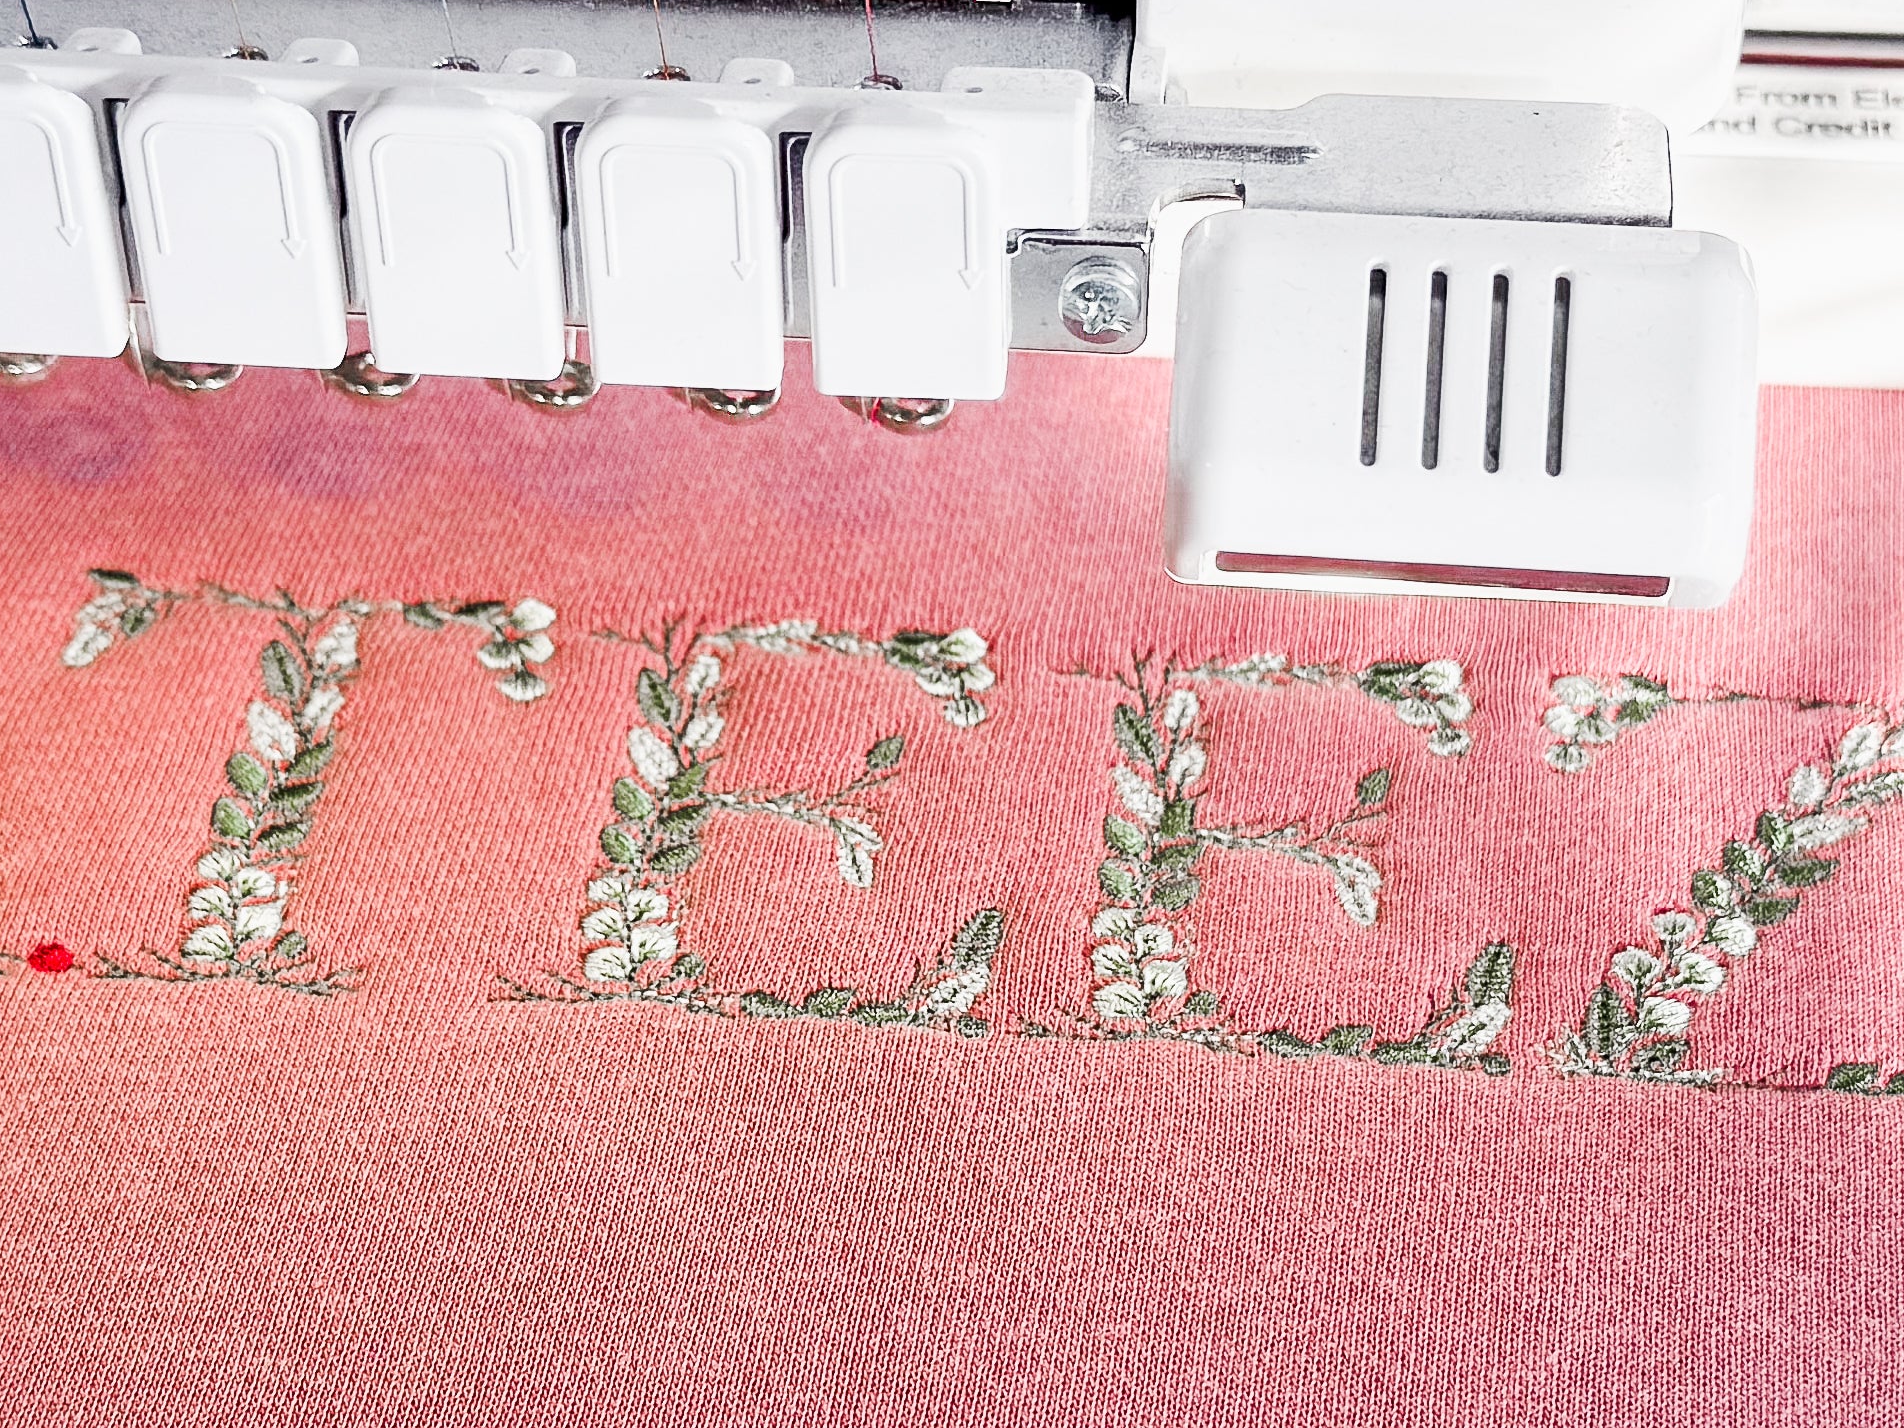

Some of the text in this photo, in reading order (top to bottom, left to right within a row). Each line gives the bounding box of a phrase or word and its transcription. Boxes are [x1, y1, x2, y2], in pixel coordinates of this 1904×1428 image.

[1735, 84, 1838, 110] From
[1702, 115, 1756, 136] nd
[1774, 117, 1895, 140] Credit
